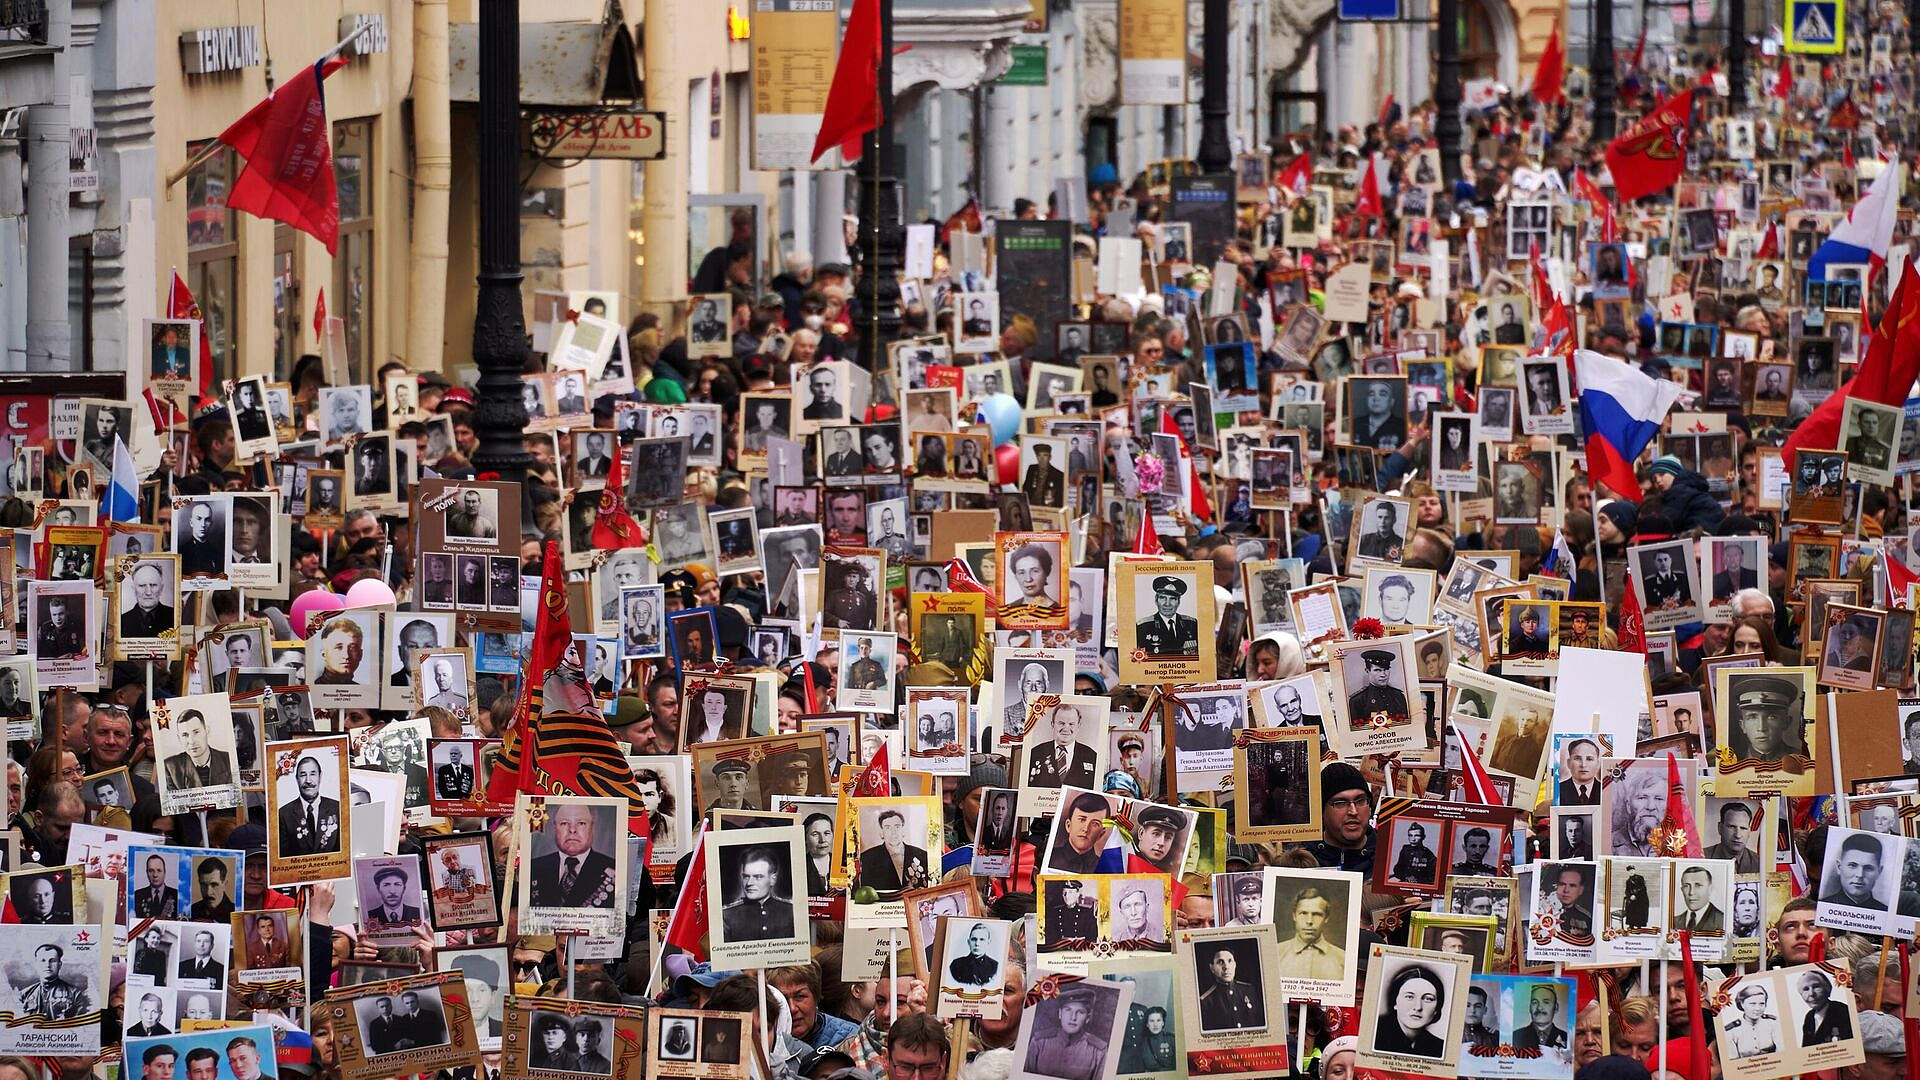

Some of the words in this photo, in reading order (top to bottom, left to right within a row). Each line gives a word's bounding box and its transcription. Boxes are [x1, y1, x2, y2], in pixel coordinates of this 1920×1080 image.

[197, 26, 260, 74] TERVOLINA
[433, 497, 457, 513] ПОЛК
[1134, 564, 1178, 573] Бессмертный
[1144, 669, 1167, 677] Виктор
[1368, 731, 1397, 740] НОСКОВ
[1354, 739, 1374, 749] БОРИС
[1375, 736, 1412, 746] АЛЕКСЕЕВИЧ
[290, 855, 329, 864] Мельников
[272, 862, 307, 873] Владимир
[308, 860, 348, 869] Алексеевич
[534, 912, 563, 921] Негрейко
[577, 912, 610, 921] Денисович
[1828, 909, 1876, 922] ОСКОЛЬСКИЙ
[1819, 915, 1843, 926] Семён
[1843, 918, 1882, 931] Данилович
[741, 942, 767, 951] Аркадий
[767, 940, 809, 949] Емельянович
[20, 1033, 78, 1042] ТАРАНСКИЙ
[15, 1041, 47, 1049] Алексей
[47, 1041, 84, 1049] Акимович
[367, 1046, 453, 1067] Никифоренко
